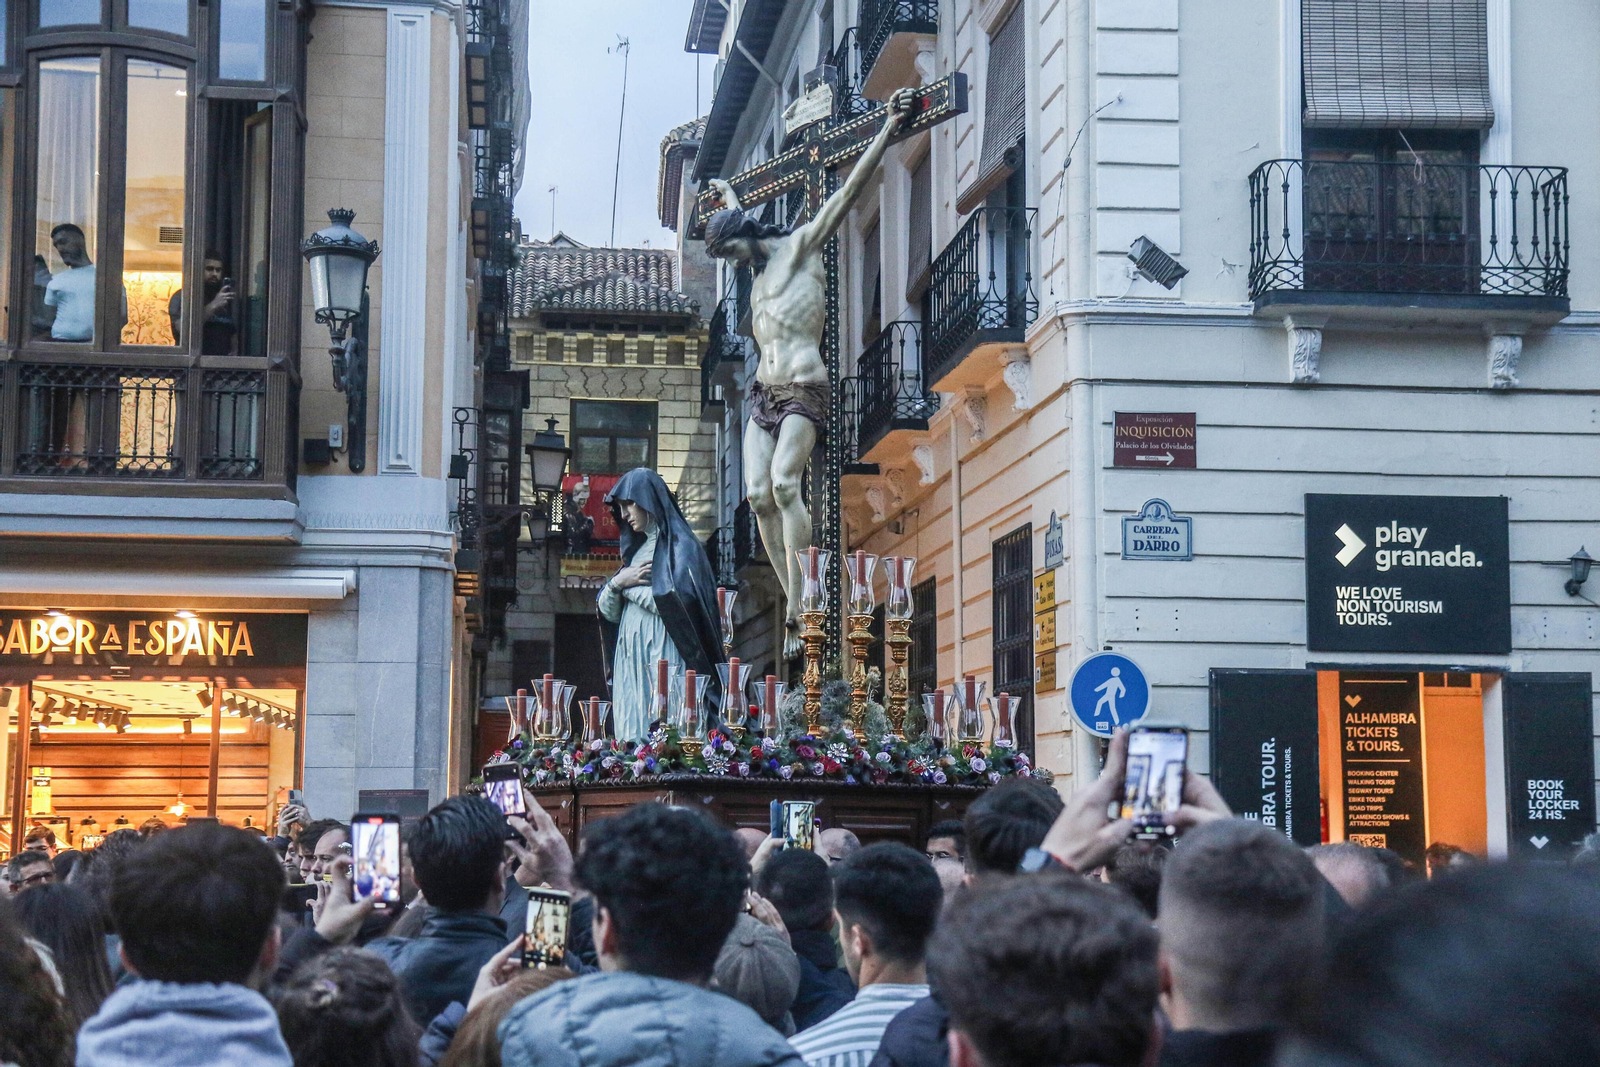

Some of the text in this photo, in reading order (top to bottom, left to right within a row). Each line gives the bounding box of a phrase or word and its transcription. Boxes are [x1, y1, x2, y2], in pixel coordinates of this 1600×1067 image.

[1136, 414, 1173, 424] Exposición
[1115, 425, 1194, 439] INQUISICIÓN
[1115, 441, 1194, 450] Palacio de los Olvidados
[1133, 525, 1180, 535] CARRERA
[1375, 520, 1428, 549] play
[1133, 539, 1181, 552] DARRO
[1375, 545, 1483, 572] granada.
[1336, 586, 1402, 600] WE LOVE
[1336, 600, 1443, 614] NON TOURISM
[1337, 612, 1392, 626] TOURS.
[127, 620, 254, 656] ESPAÑA
[1345, 713, 1417, 724] ALHAMBRA
[1345, 726, 1398, 738] TICKETS
[1346, 740, 1404, 752] & TOURS.
[1261, 737, 1277, 830] BRA TOUR.
[1528, 780, 1564, 790] BOOK
[1284, 781, 1292, 808] TICKETS
[1528, 790, 1563, 800] YOUR
[1528, 800, 1580, 810] LOCKER
[1528, 810, 1566, 820] 24 HS.
